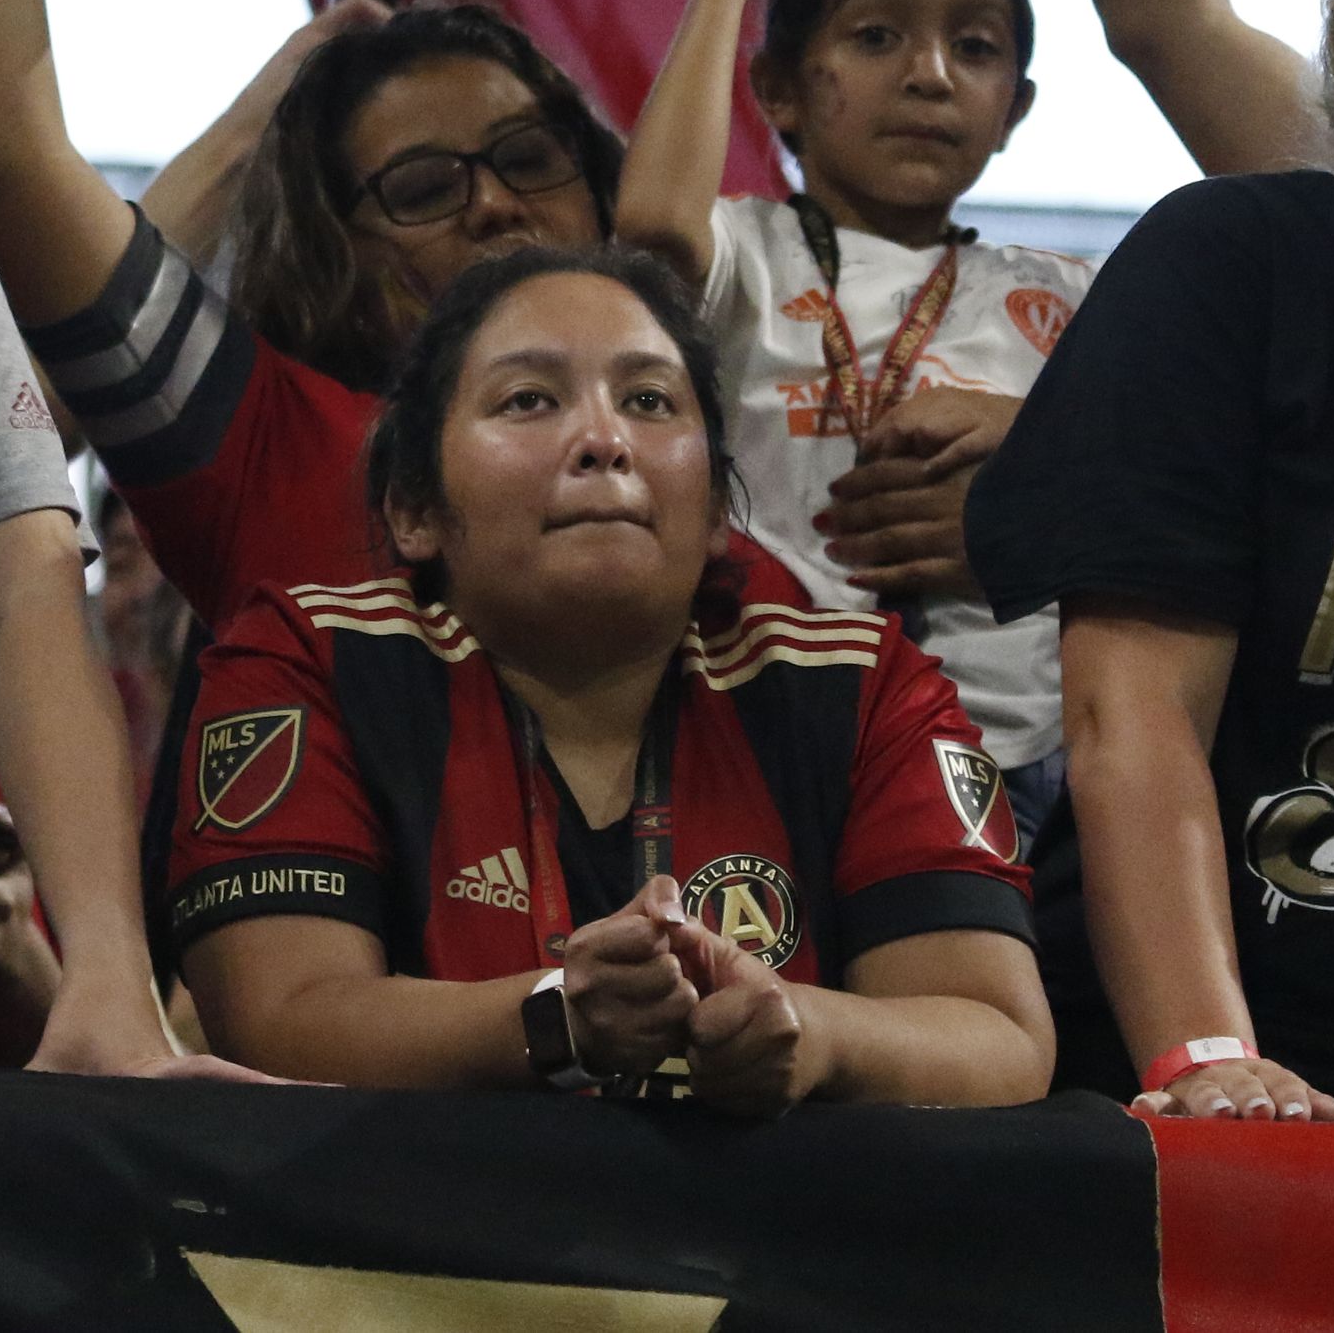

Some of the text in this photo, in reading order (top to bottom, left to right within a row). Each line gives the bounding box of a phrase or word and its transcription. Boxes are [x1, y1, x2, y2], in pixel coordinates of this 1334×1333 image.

[208, 722, 257, 755] MLS
[947, 753, 990, 785] MLS
[250, 867, 347, 897] UNITED
[689, 858, 778, 897] ATLANTA
[446, 878, 530, 915] adida
